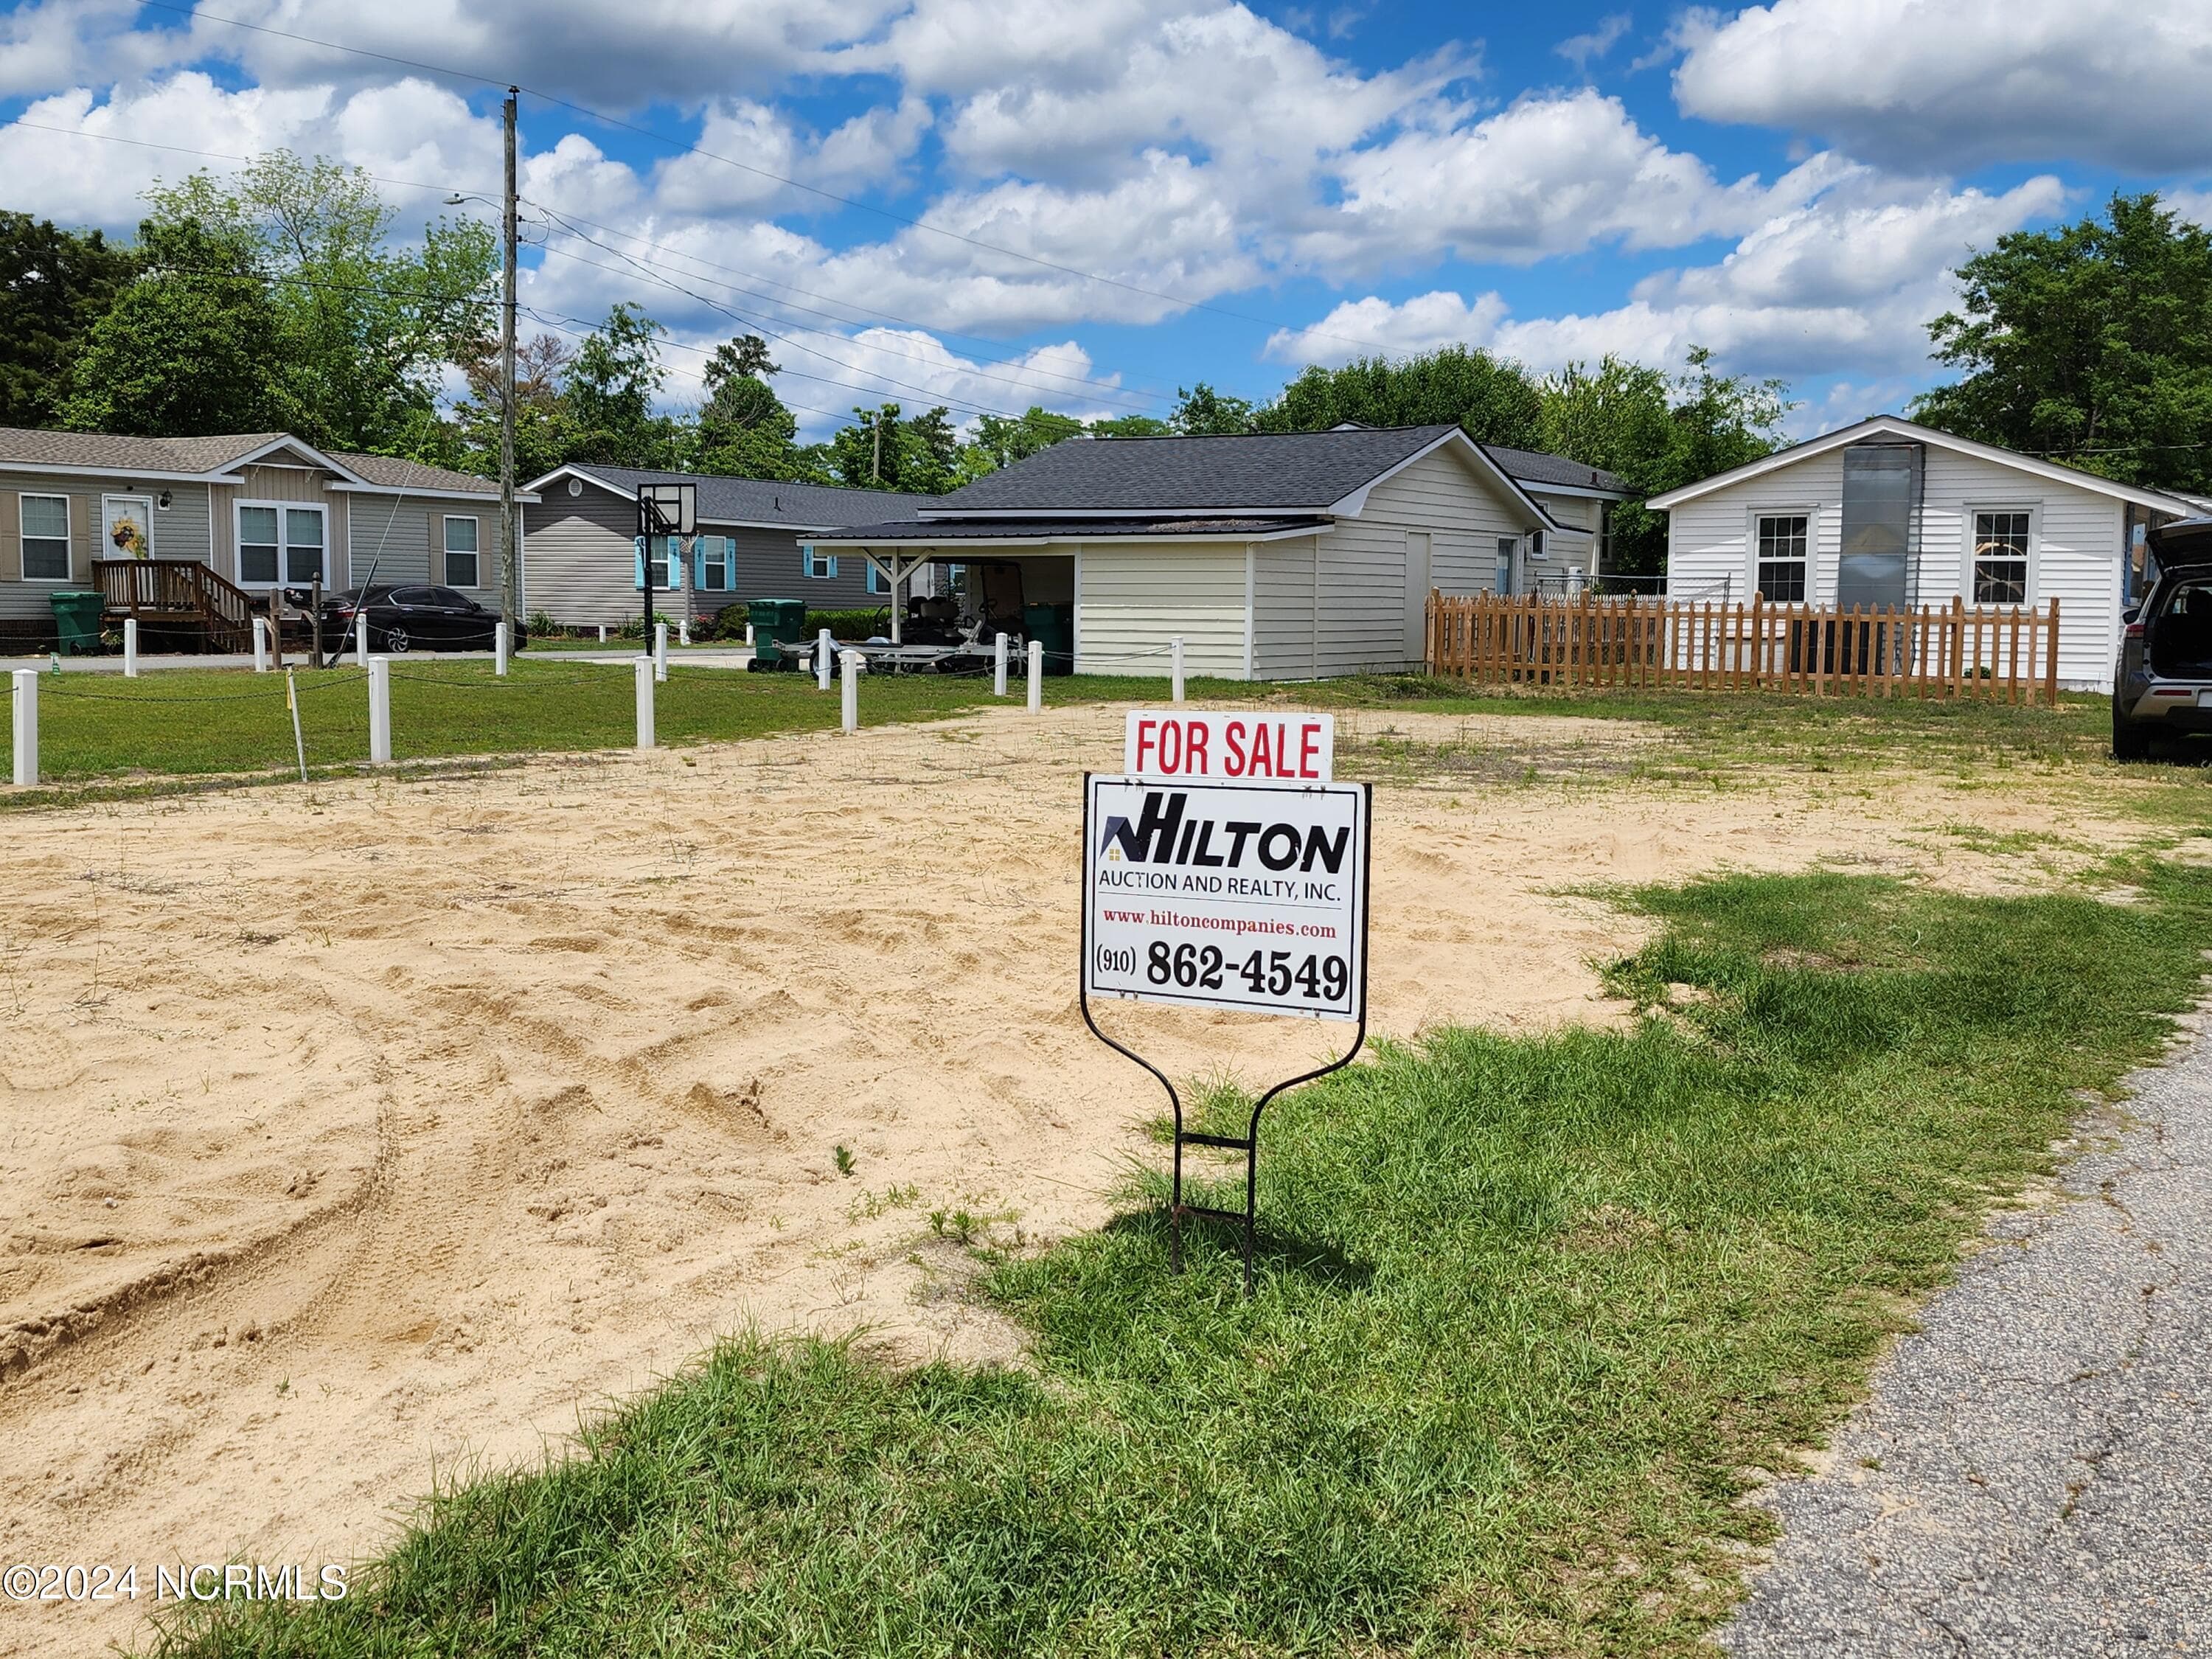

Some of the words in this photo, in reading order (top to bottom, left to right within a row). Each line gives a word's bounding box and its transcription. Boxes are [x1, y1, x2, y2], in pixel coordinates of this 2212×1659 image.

[1136, 720, 1208, 775] FOR
[1224, 721, 1321, 779] SALE
[1130, 792, 1350, 874] HILTON
[1099, 870, 1177, 890] AUCTION
[1182, 877, 1222, 893] AND
[1228, 877, 1298, 900] REALTY,
[1304, 883, 1341, 902] INC.
[1104, 909, 1337, 939] www.hiltoncompanies.com
[1096, 944, 1136, 975] (910)
[1147, 941, 1348, 1001] 862-4549
